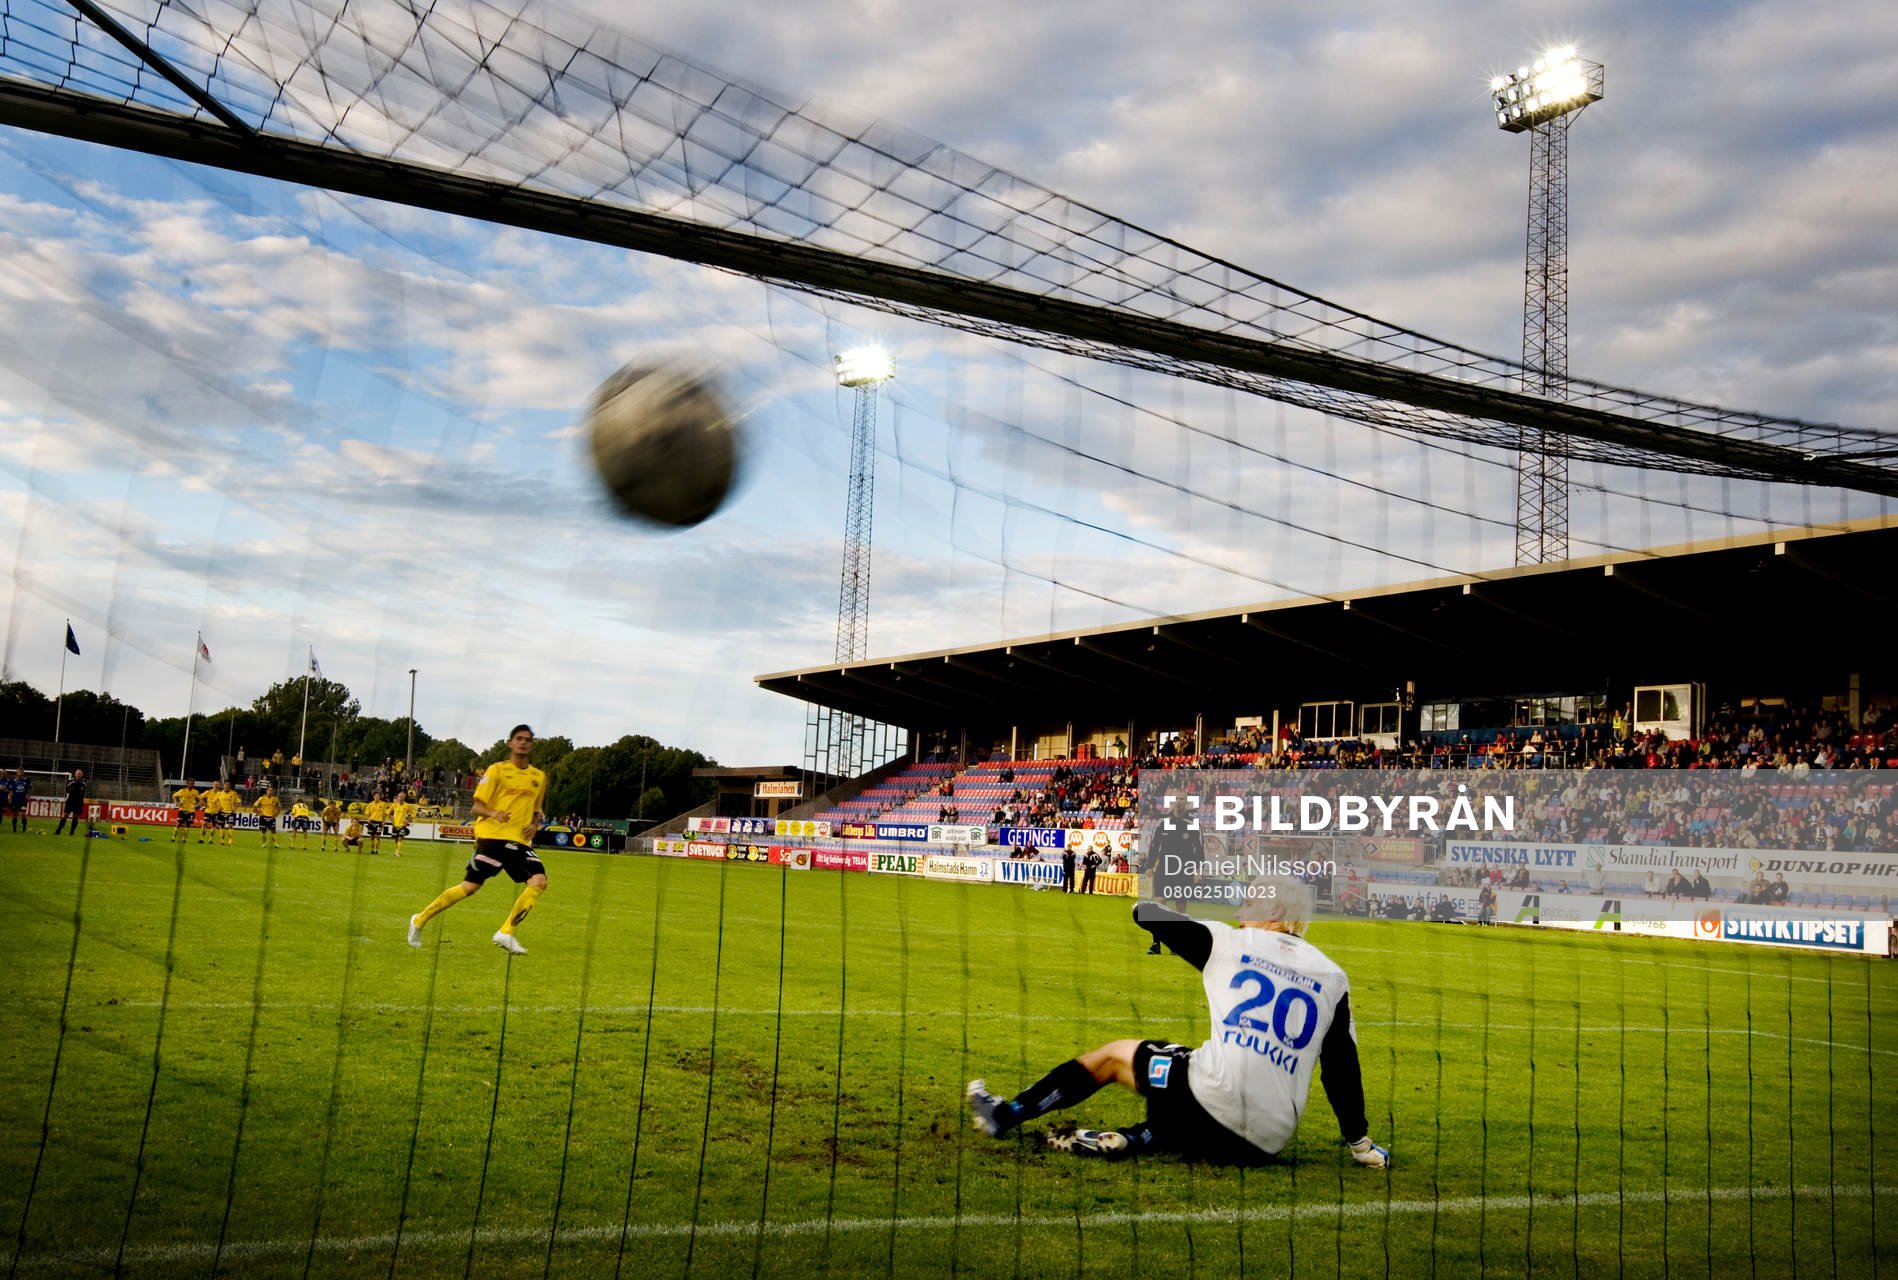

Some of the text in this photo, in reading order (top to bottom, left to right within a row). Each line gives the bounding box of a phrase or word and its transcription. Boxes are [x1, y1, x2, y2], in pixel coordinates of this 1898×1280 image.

[879, 826, 926, 838] UMBRO
[1007, 829, 1056, 847] GETINGE
[877, 854, 917, 873] PEAB
[1451, 845, 1577, 866] SVENSKA LYFT
[1001, 861, 1064, 885] WIWOOD
[1765, 858, 1898, 877] DUNLOP HIF
[1727, 911, 1860, 945] STRYKTIPSET
[1222, 969, 1318, 1050] 20
